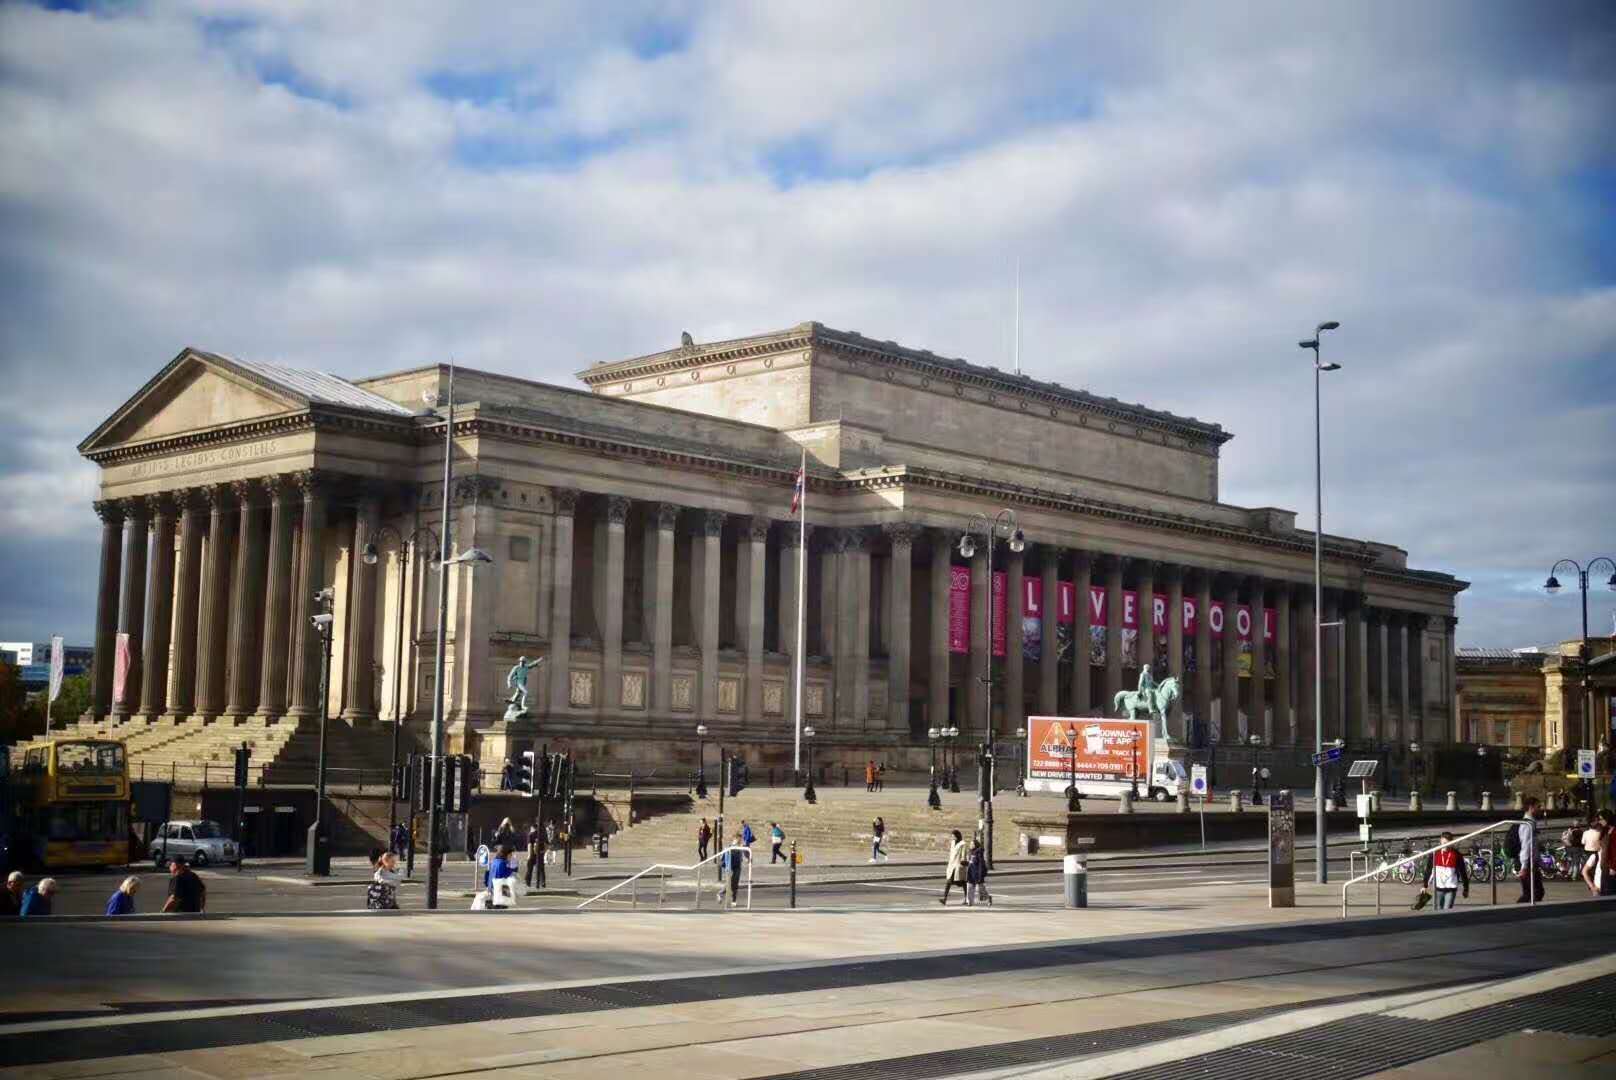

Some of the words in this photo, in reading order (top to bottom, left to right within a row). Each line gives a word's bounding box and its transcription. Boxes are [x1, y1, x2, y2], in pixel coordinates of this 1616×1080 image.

[1027, 581, 1272, 638] LIVERPOOL
[1040, 744, 1073, 753] ALPHA
[1032, 770, 1047, 778] NEW
[1075, 772, 1103, 780] WANTED
